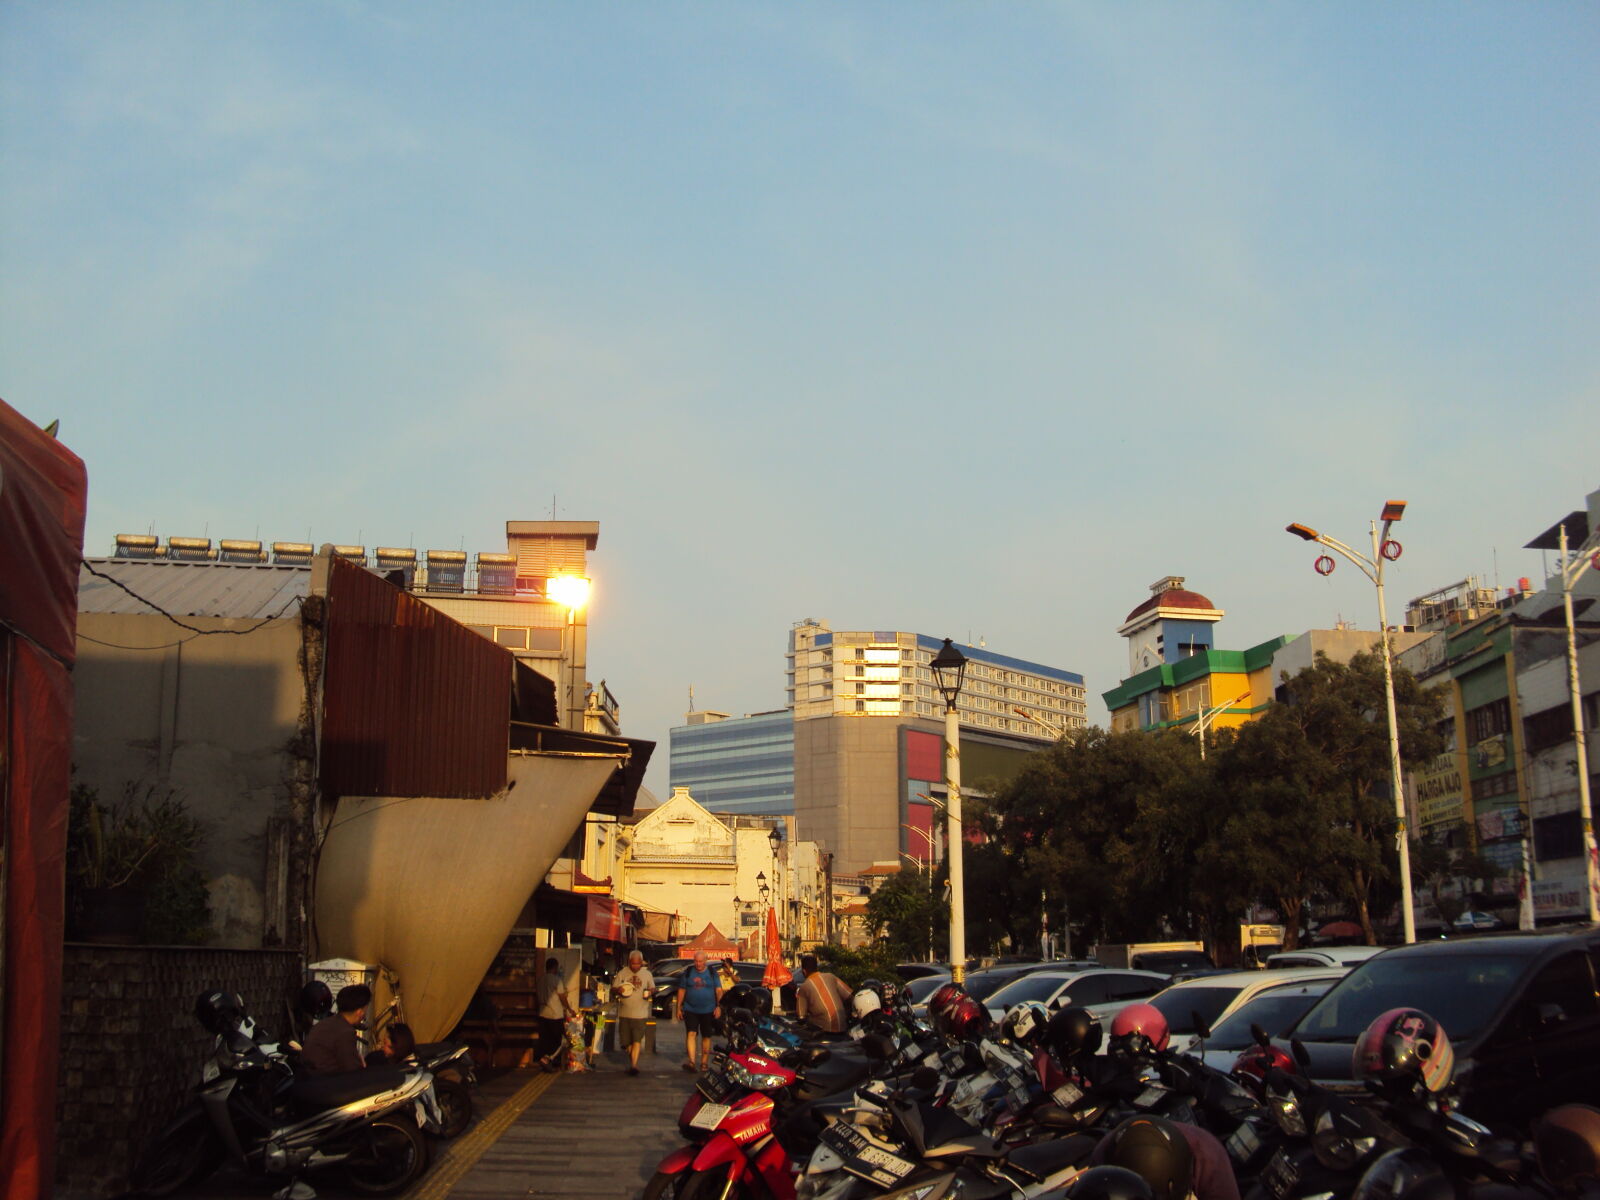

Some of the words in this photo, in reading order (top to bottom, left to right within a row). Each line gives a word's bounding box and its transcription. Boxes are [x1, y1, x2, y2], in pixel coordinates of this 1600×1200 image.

[1417, 777, 1445, 803] HARGA
[706, 951, 736, 959] WARKOP
[740, 1122, 767, 1141] YAMAHA
